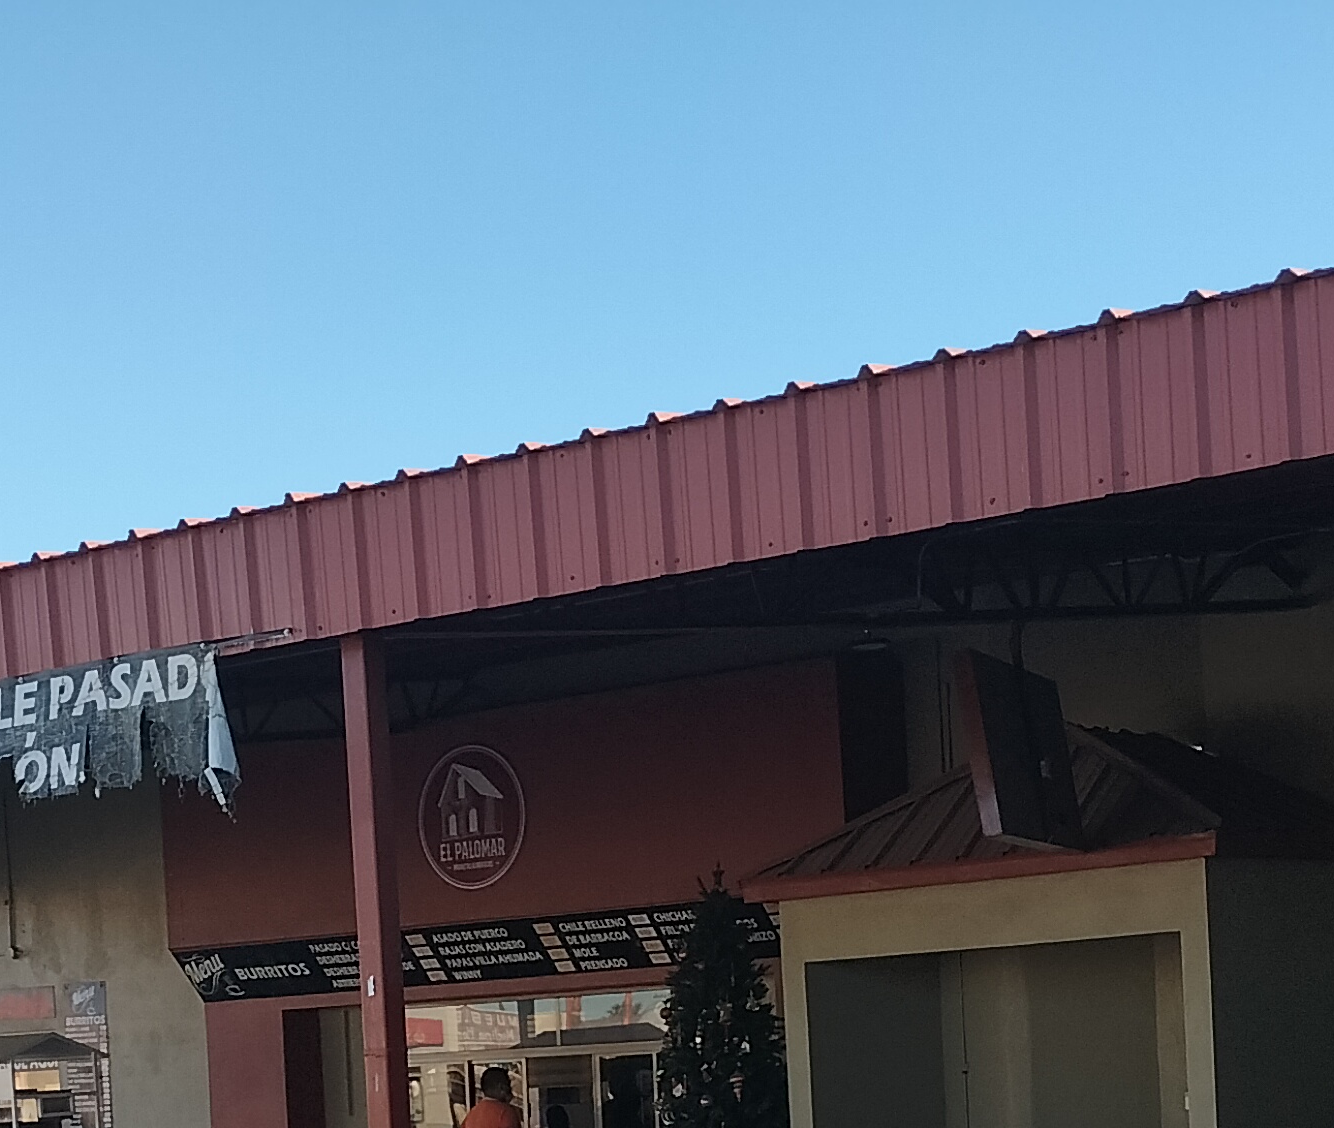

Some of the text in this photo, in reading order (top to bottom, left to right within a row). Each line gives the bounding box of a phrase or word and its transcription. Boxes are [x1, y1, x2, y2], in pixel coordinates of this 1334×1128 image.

[49, 653, 215, 721] PASAD
[440, 838, 505, 861] EL PALOMAR
[558, 921, 584, 933] CHILE
[585, 917, 627, 930] RELLENO
[432, 932, 460, 943] ASADO
[462, 932, 473, 941] DE
[474, 927, 508, 939] PUERCO
[565, 934, 579, 945] DE
[579, 930, 630, 943] BARBACOA
[308, 942, 341, 954] PASADO
[438, 944, 465, 956] RAJAS
[466, 942, 485, 953] CON
[485, 939, 526, 950] ASADERO
[572, 946, 599, 957] MOLE
[445, 956, 471, 968] PAPAS
[471, 955, 498, 966] VILLA
[498, 950, 543, 964] AHUMADA
[579, 957, 628, 971] PRENSADO
[234, 962, 311, 981] BURRITOS
